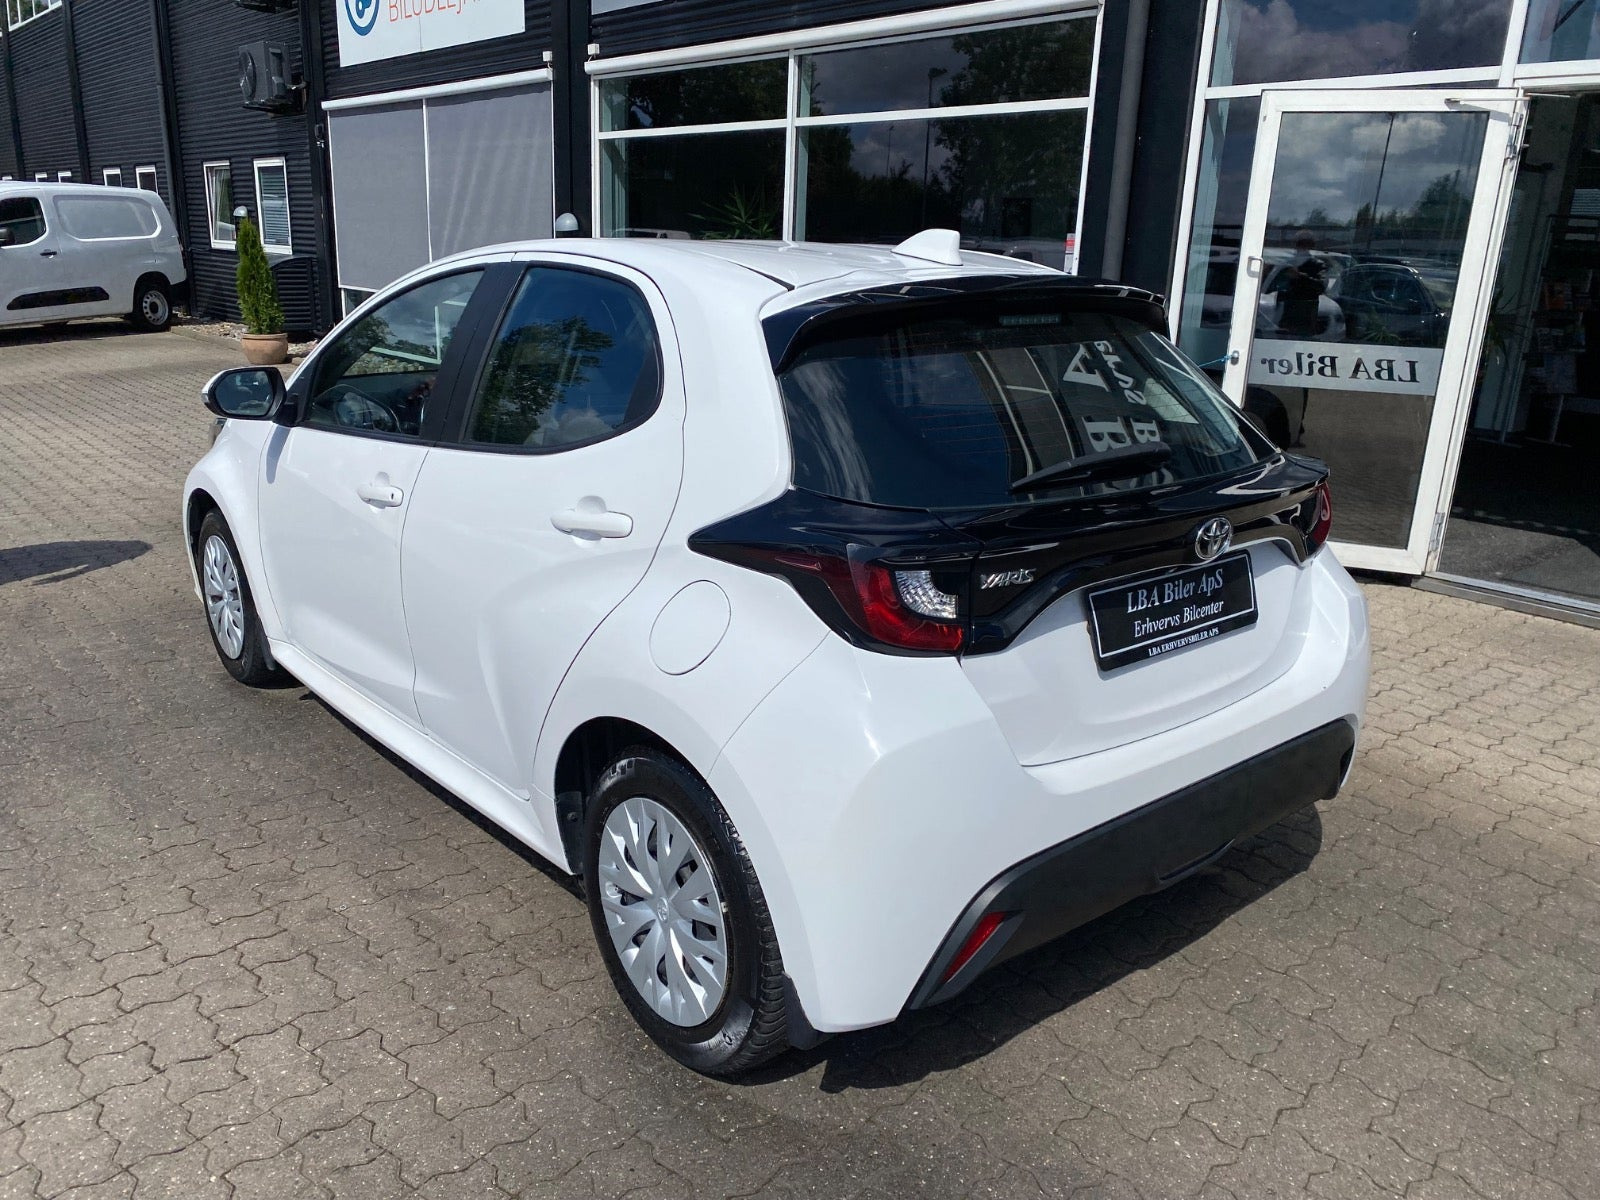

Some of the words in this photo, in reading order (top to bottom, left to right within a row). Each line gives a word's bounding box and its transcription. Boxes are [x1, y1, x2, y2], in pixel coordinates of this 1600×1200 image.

[1126, 585, 1160, 613] LBA
[1163, 580, 1195, 604] Biler
[1197, 568, 1223, 597] ApS
[1134, 614, 1181, 638] Erhvervs
[1183, 600, 1224, 623] Bilcenter
[1148, 646, 1161, 656] LBA
[1208, 626, 1219, 637] APS
